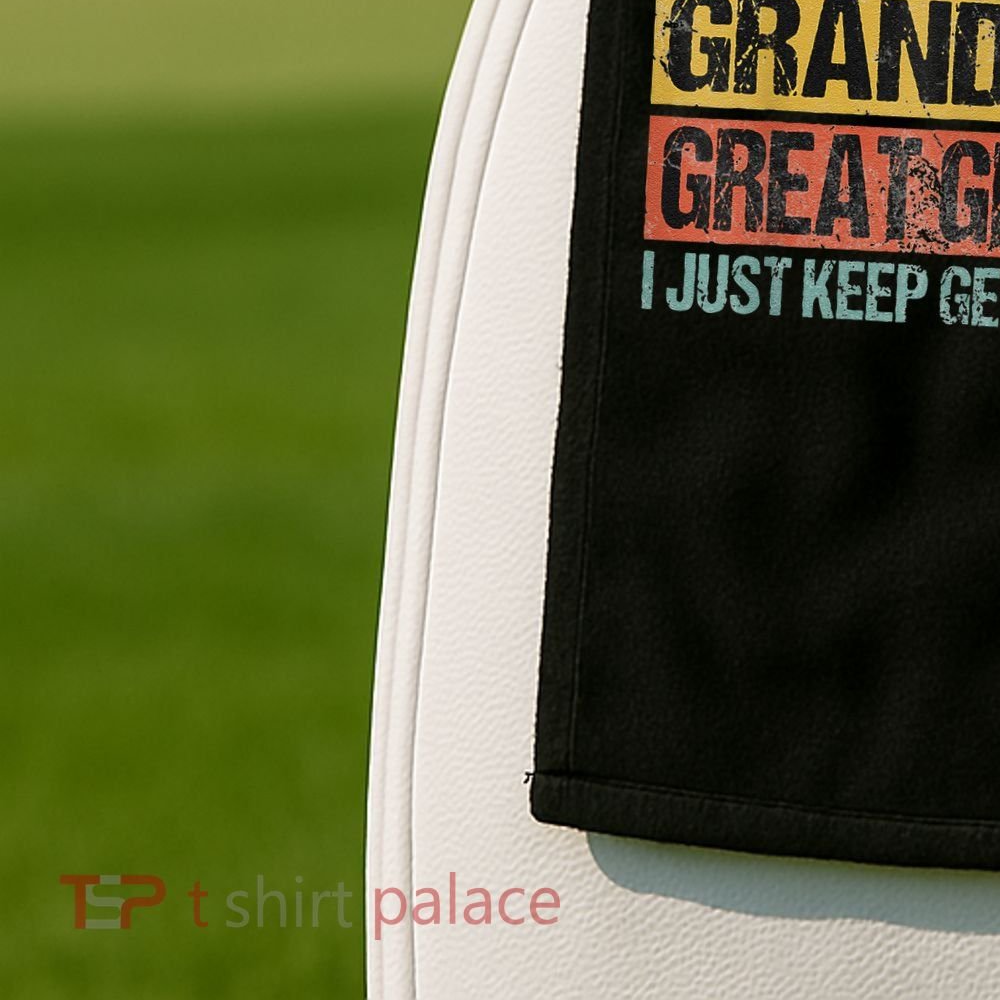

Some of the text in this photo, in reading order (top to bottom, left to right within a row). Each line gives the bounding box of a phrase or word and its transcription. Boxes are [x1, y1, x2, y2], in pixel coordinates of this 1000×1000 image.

[661, 125, 922, 240] GREAT
[640, 250, 655, 310] I
[665, 252, 793, 317] JUST
[802, 258, 929, 324] KEEP
